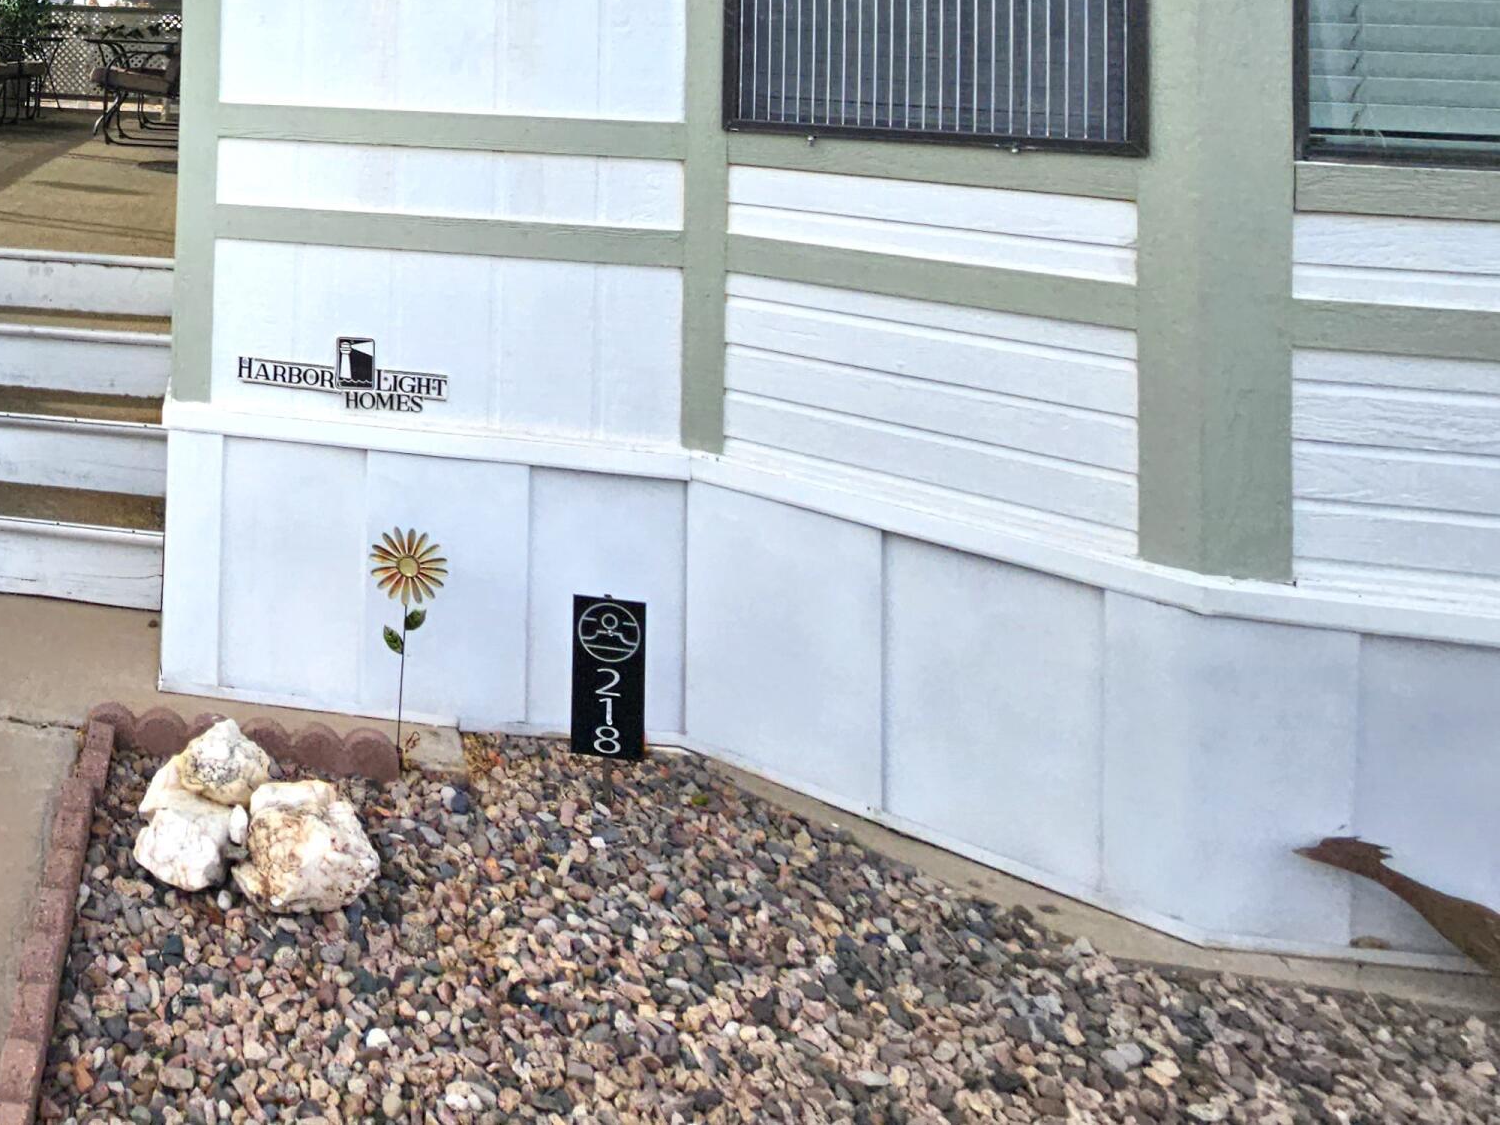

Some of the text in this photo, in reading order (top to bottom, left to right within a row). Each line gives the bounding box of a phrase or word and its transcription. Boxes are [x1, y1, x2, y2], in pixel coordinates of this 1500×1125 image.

[238, 356, 447, 396] HARBOR LIGHT
[345, 391, 423, 412] HOMES
[593, 668, 621, 754] 218
